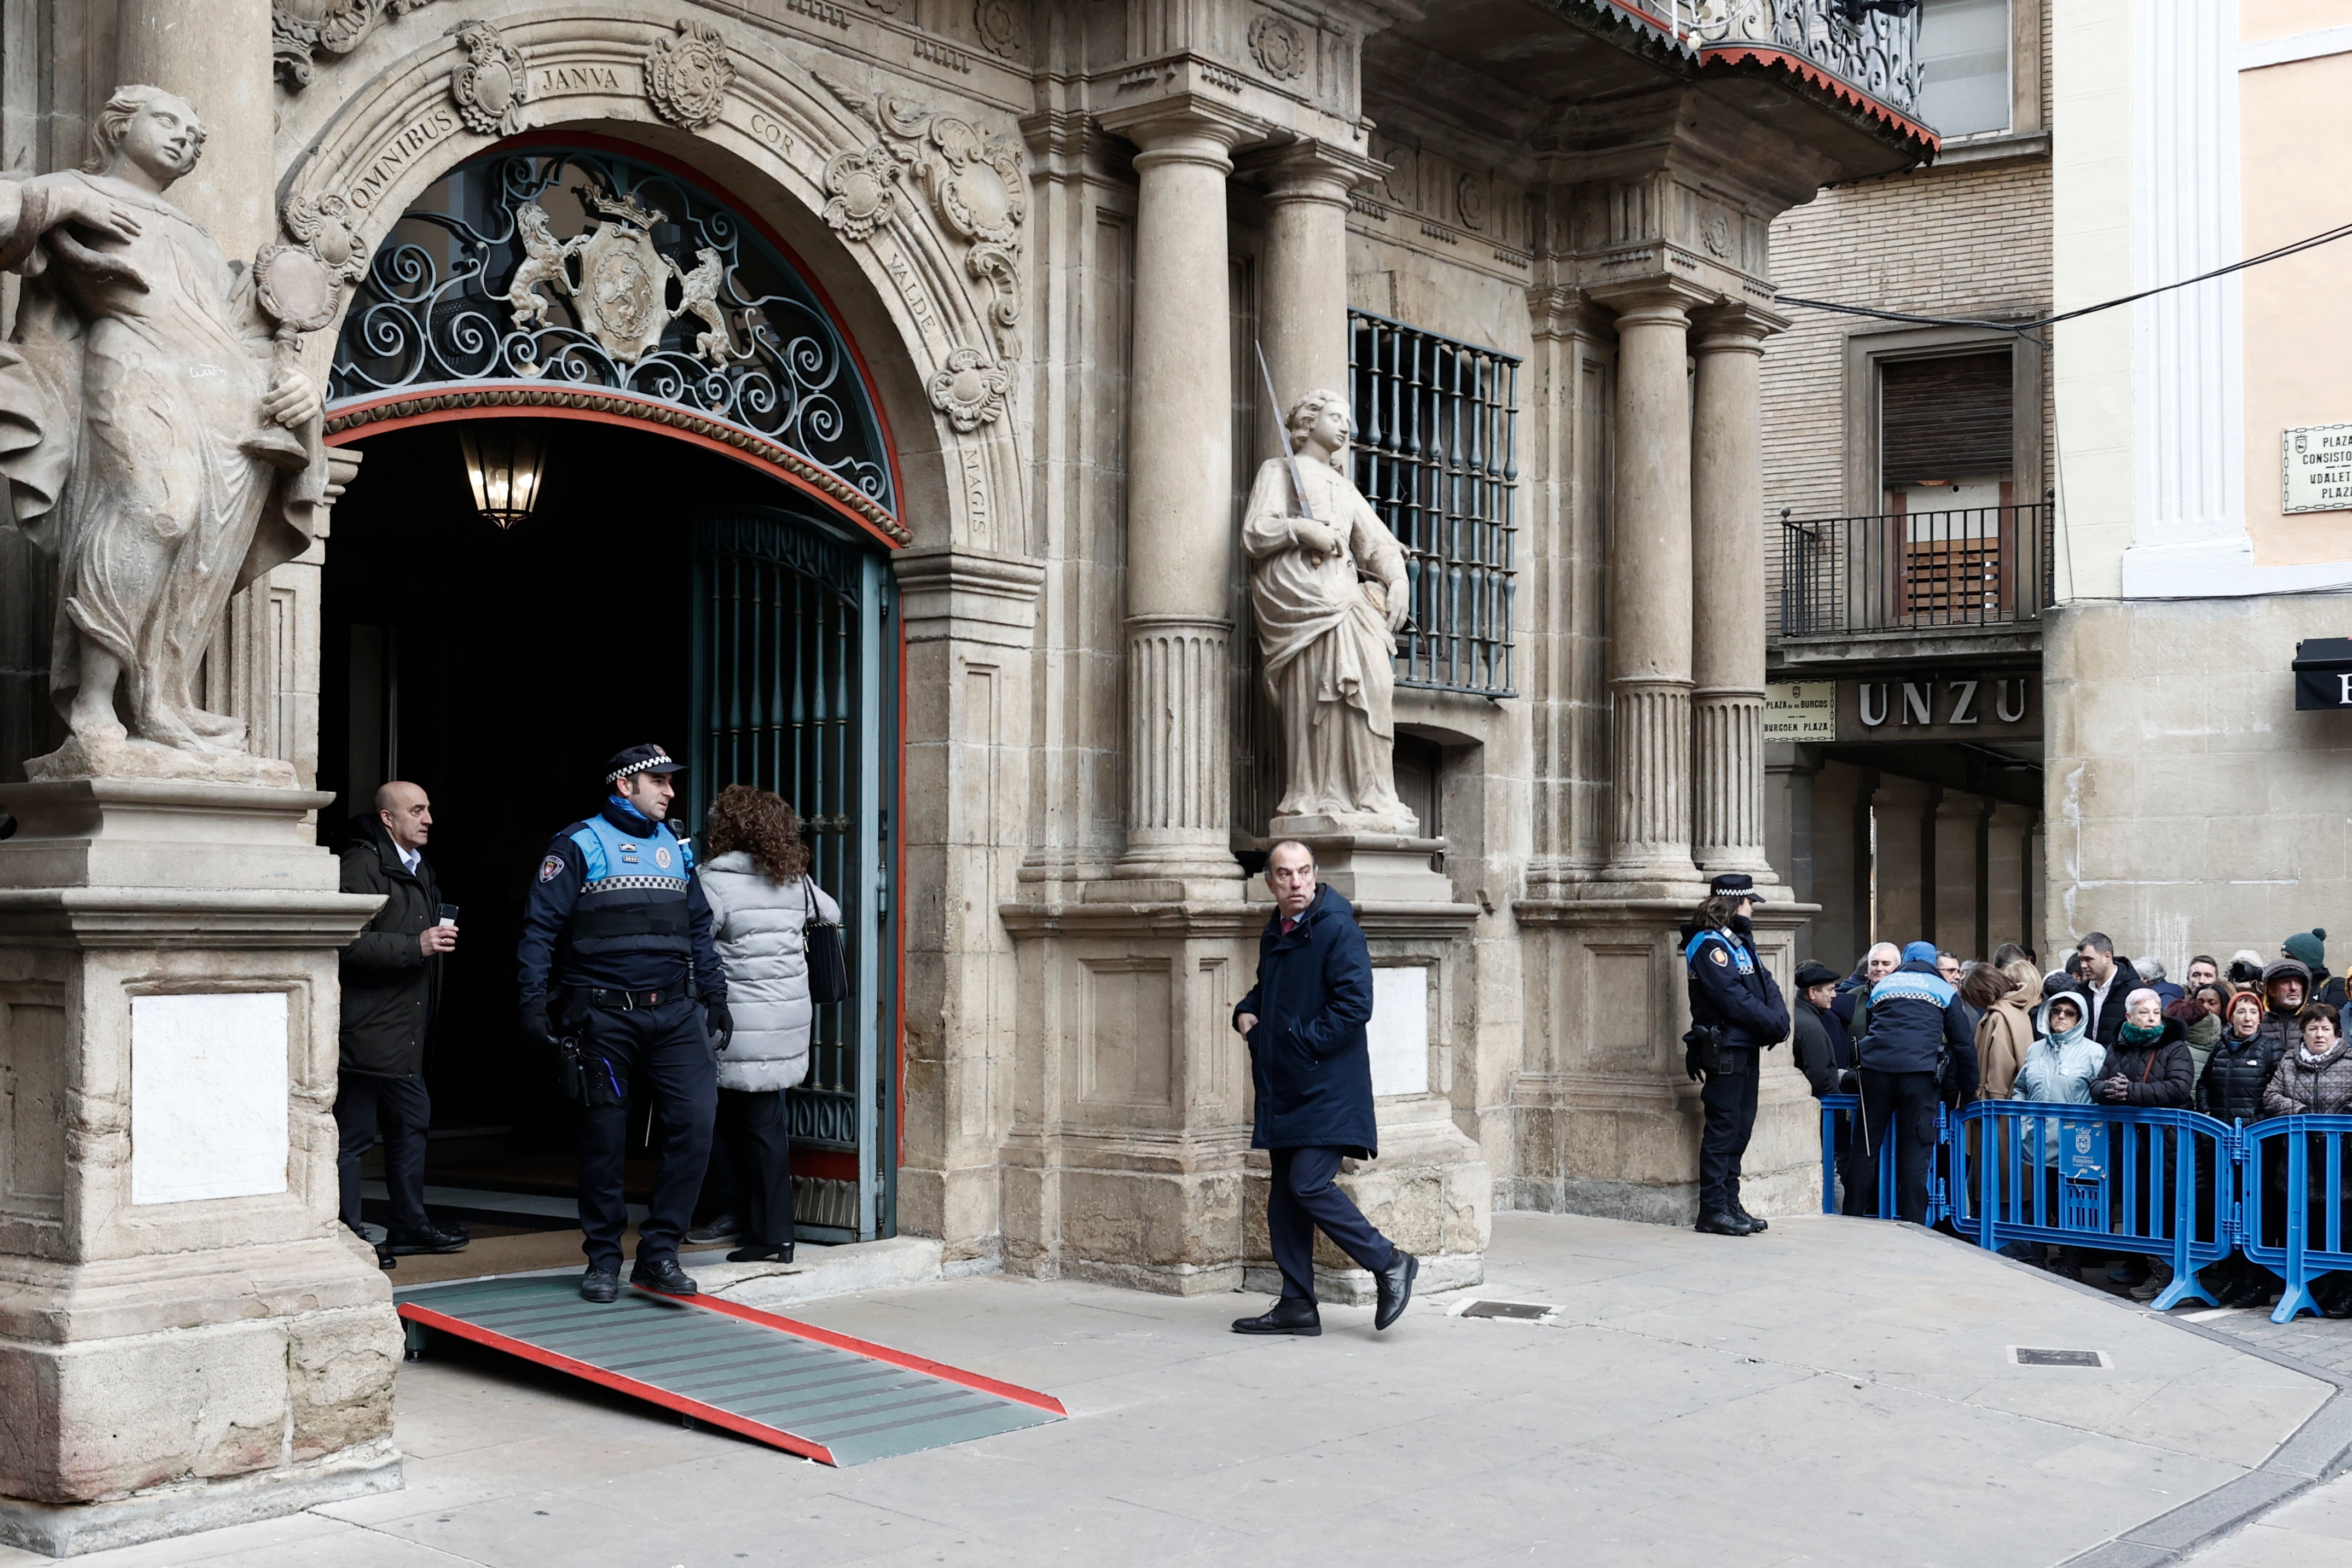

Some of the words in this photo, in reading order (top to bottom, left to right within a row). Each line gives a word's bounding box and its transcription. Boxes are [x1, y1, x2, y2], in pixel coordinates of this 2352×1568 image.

[351, 111, 453, 208] OMNIBUS
[543, 68, 619, 90] JANVA
[751, 114, 794, 158] COR
[886, 253, 936, 333] VALDE
[965, 448, 986, 533] MAGIS
[2303, 451, 2351, 464] CONSISTO
[1766, 701, 1787, 709] PLAZA
[1859, 679, 2025, 726] UNZU
[1804, 723, 1828, 731] PLAZA
